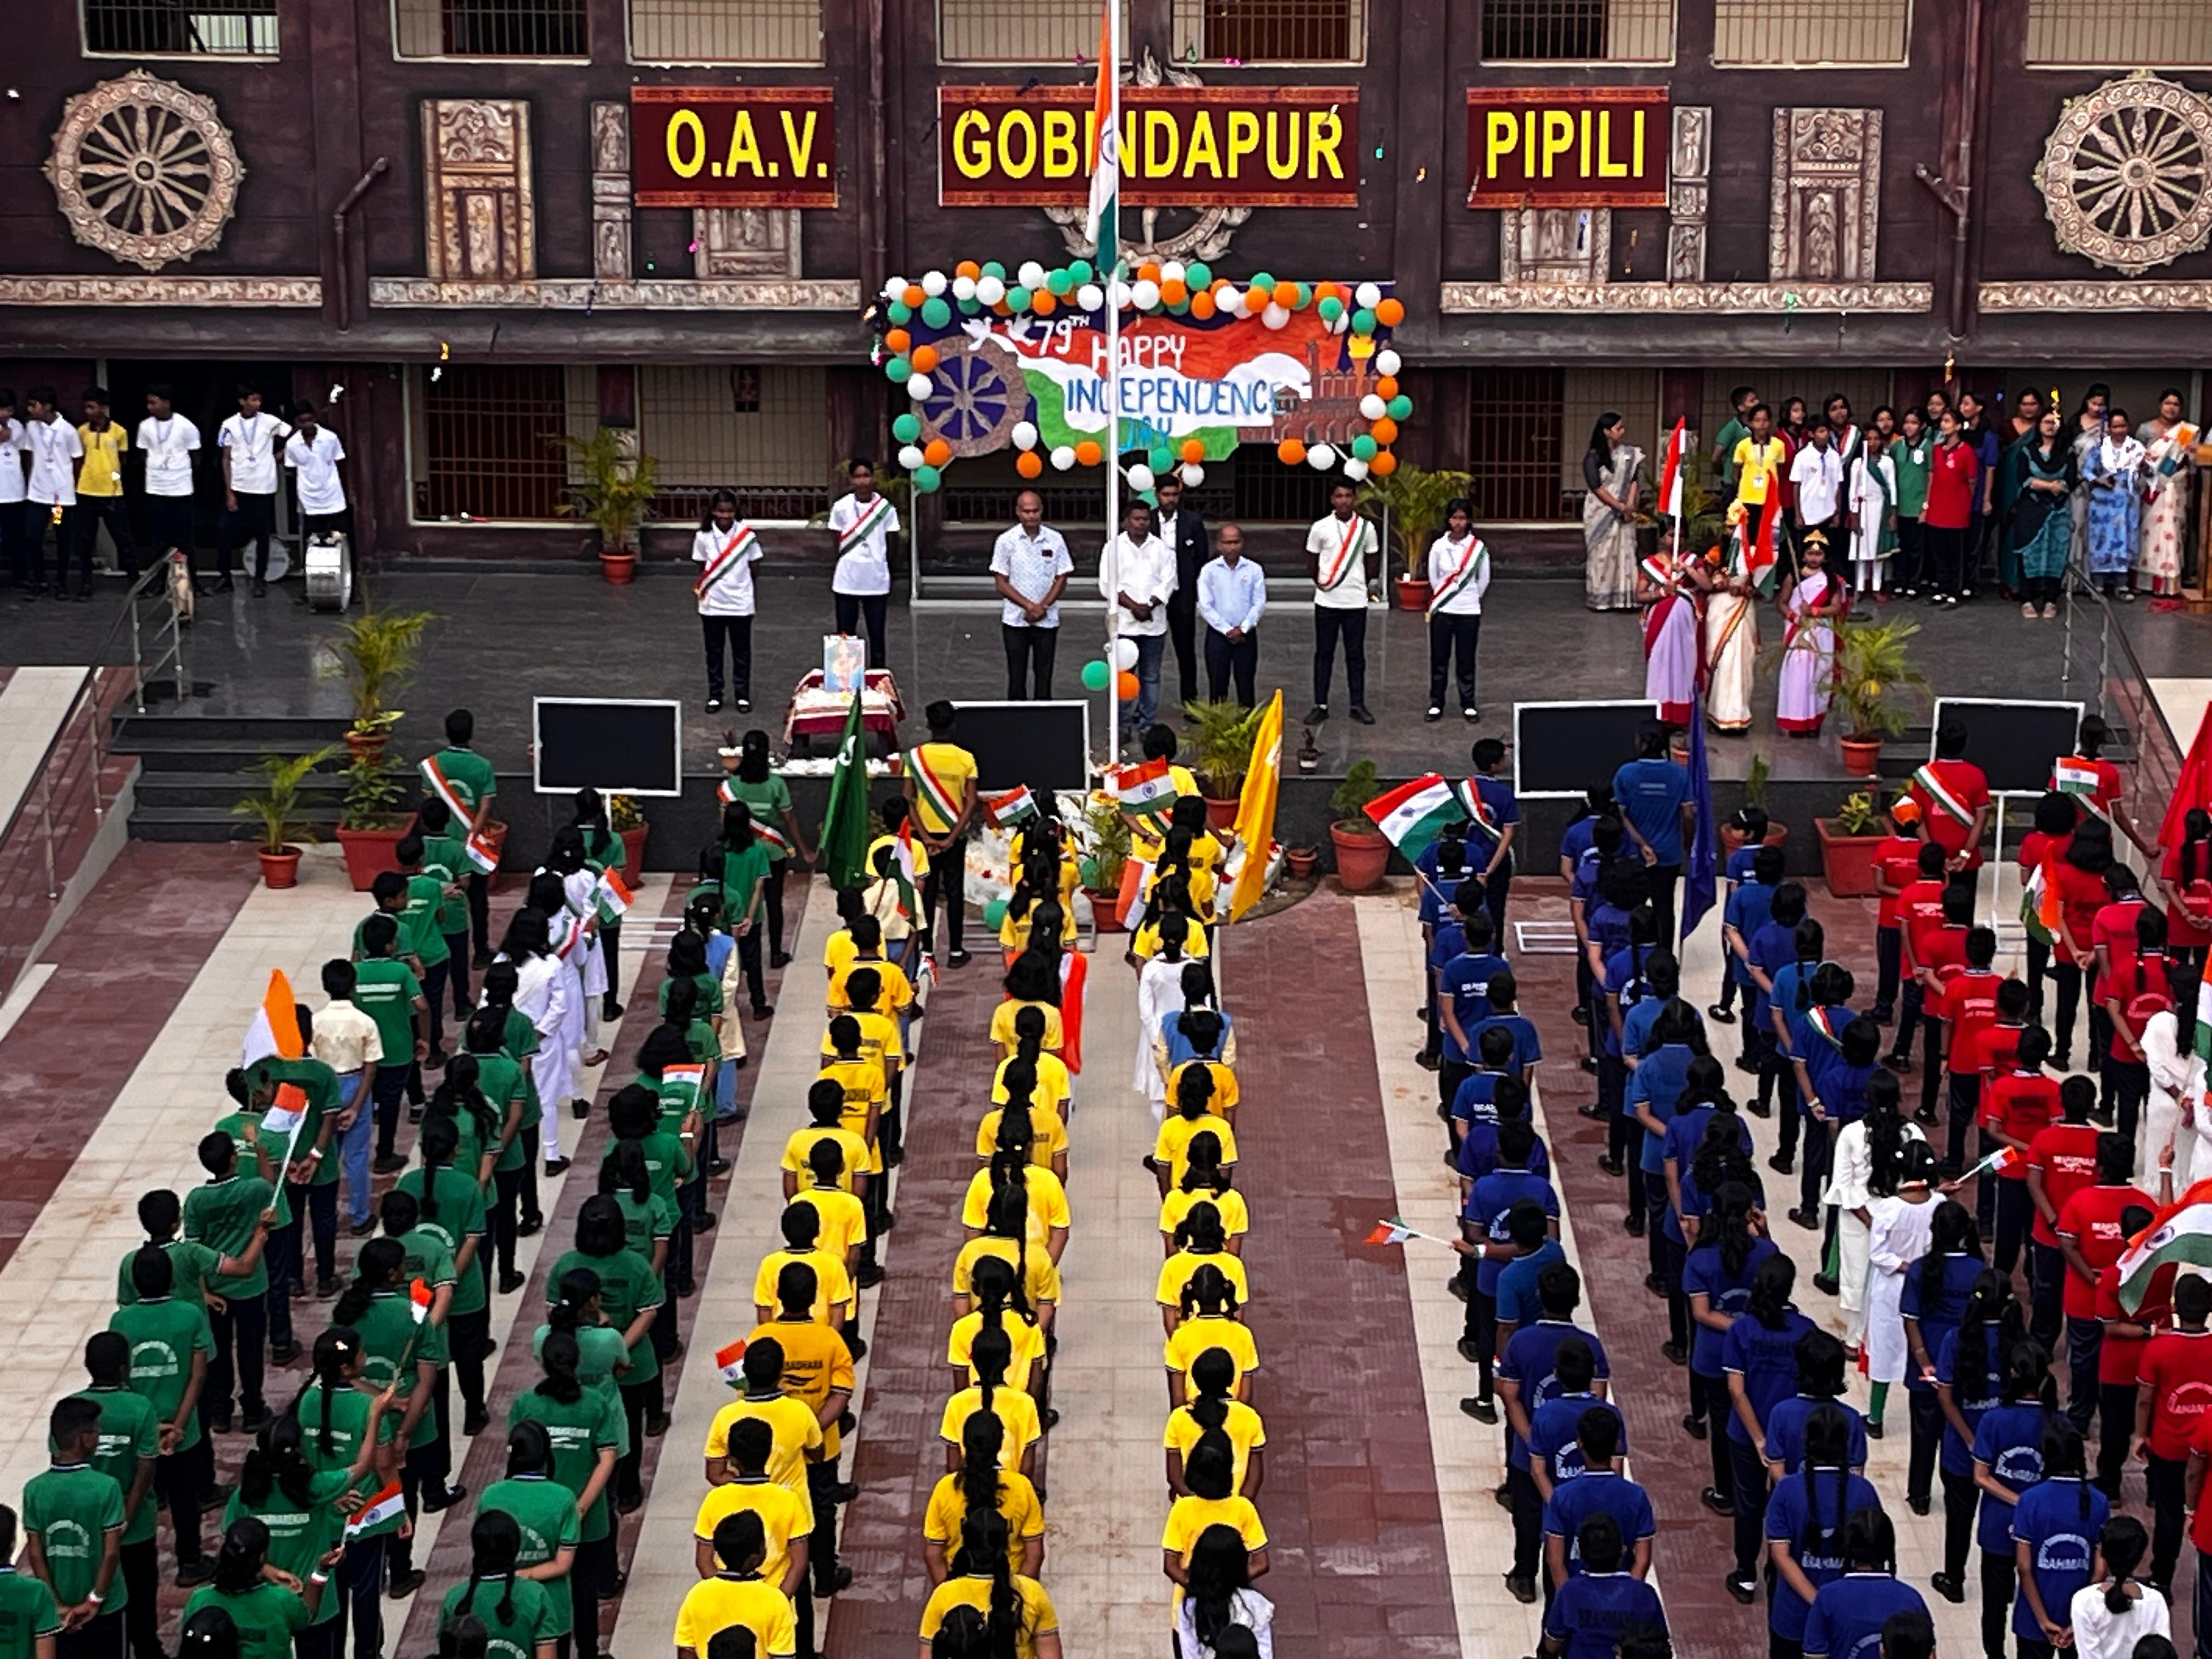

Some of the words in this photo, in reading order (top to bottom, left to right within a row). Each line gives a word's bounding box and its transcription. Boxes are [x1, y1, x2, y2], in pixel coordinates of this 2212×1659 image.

[667, 109, 827, 177] O.A.V.
[952, 109, 1343, 179] GOBINDAPUR
[1487, 110, 1645, 177] PIPILI
[1091, 334, 1187, 372] HAPPY
